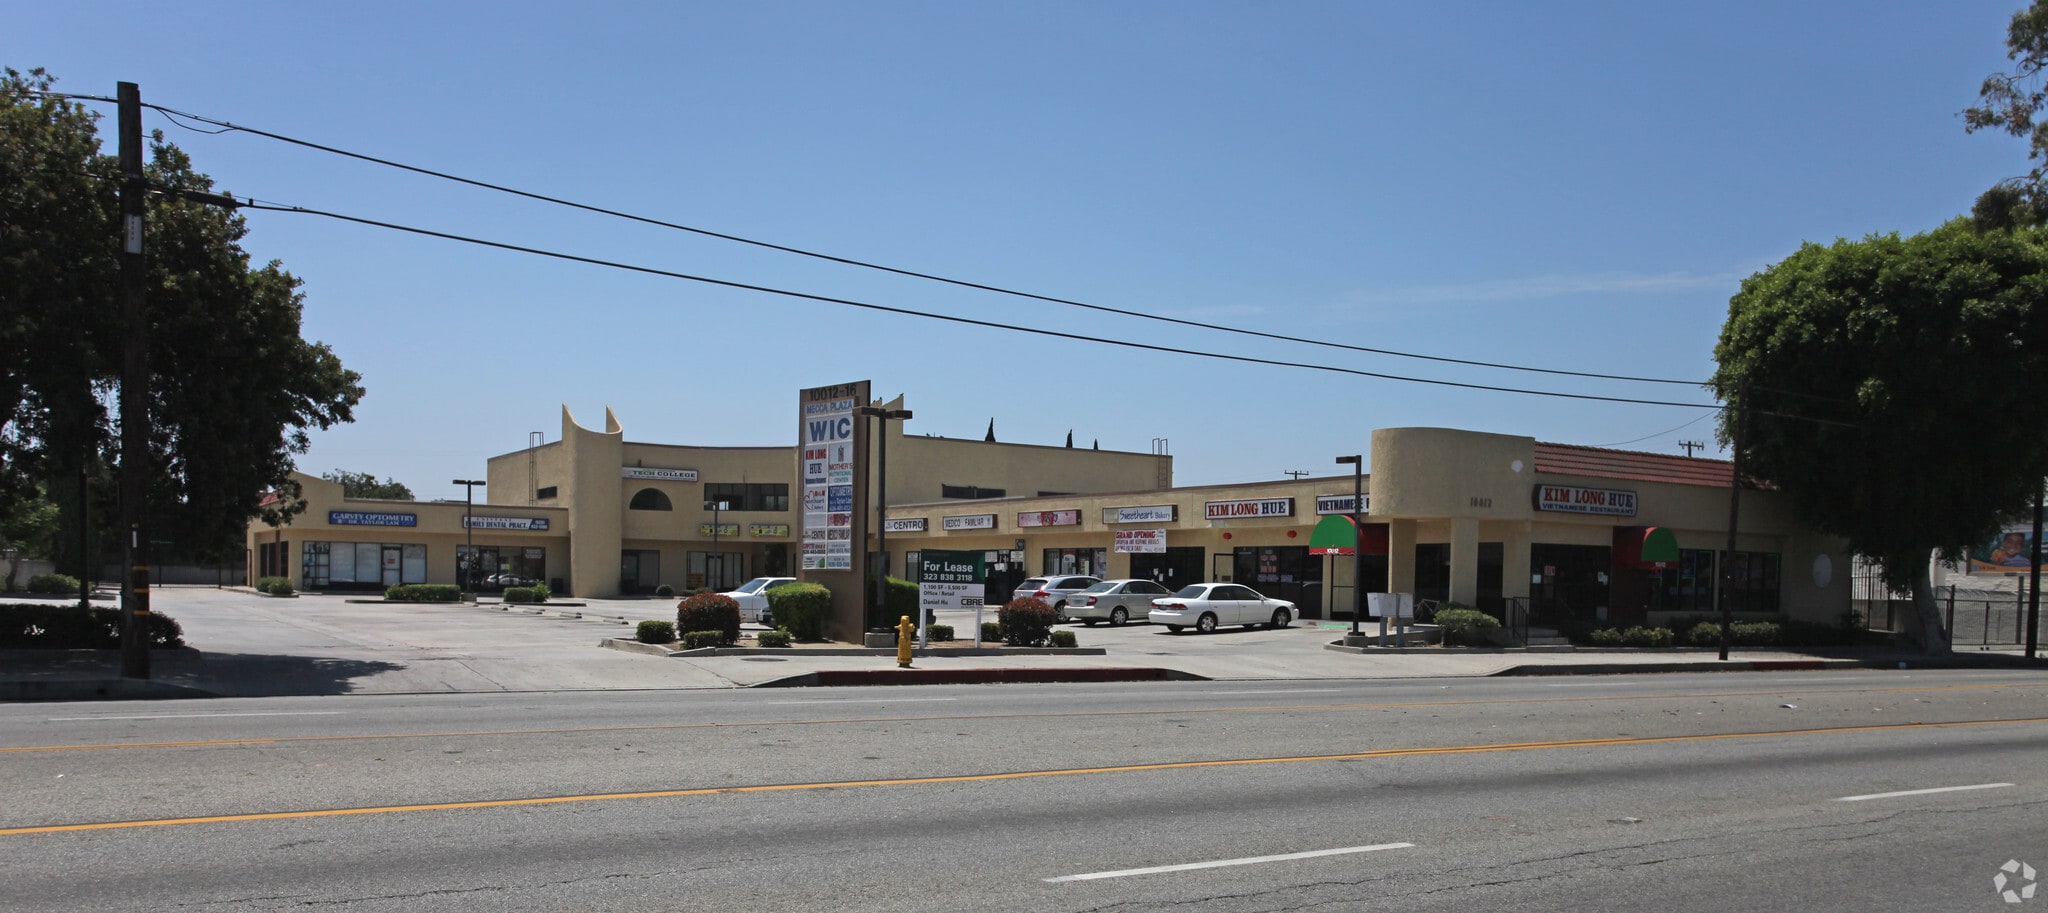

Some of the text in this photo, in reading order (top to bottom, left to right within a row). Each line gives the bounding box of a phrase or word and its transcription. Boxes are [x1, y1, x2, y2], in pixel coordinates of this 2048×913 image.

[809, 384, 857, 401] 10012-16
[830, 399, 852, 411] PLAZA
[809, 417, 851, 442] WIC
[805, 448, 826, 460] KIM LONG
[809, 462, 822, 474] HUE
[1543, 487, 1633, 508] KIM LONG HUE
[1119, 509, 1170, 521] Sweetheart Bakery
[1208, 501, 1286, 517] KIM LONG HUE
[1541, 503, 1634, 515] VIETNAMESE RESTAURANT
[332, 512, 415, 522] GARVEY OPTOMETRY
[944, 517, 984, 528] MEDICO FAMILIAR
[486, 521, 507, 529] DENTAL
[893, 520, 923, 530] CENTRO
[1116, 531, 1133, 539] GRAND
[1134, 530, 1156, 538] OPENING
[923, 561, 973, 573] For Lease
[940, 573, 954, 581] 838
[956, 574, 973, 582] 3118
[960, 598, 983, 606] CBRE
